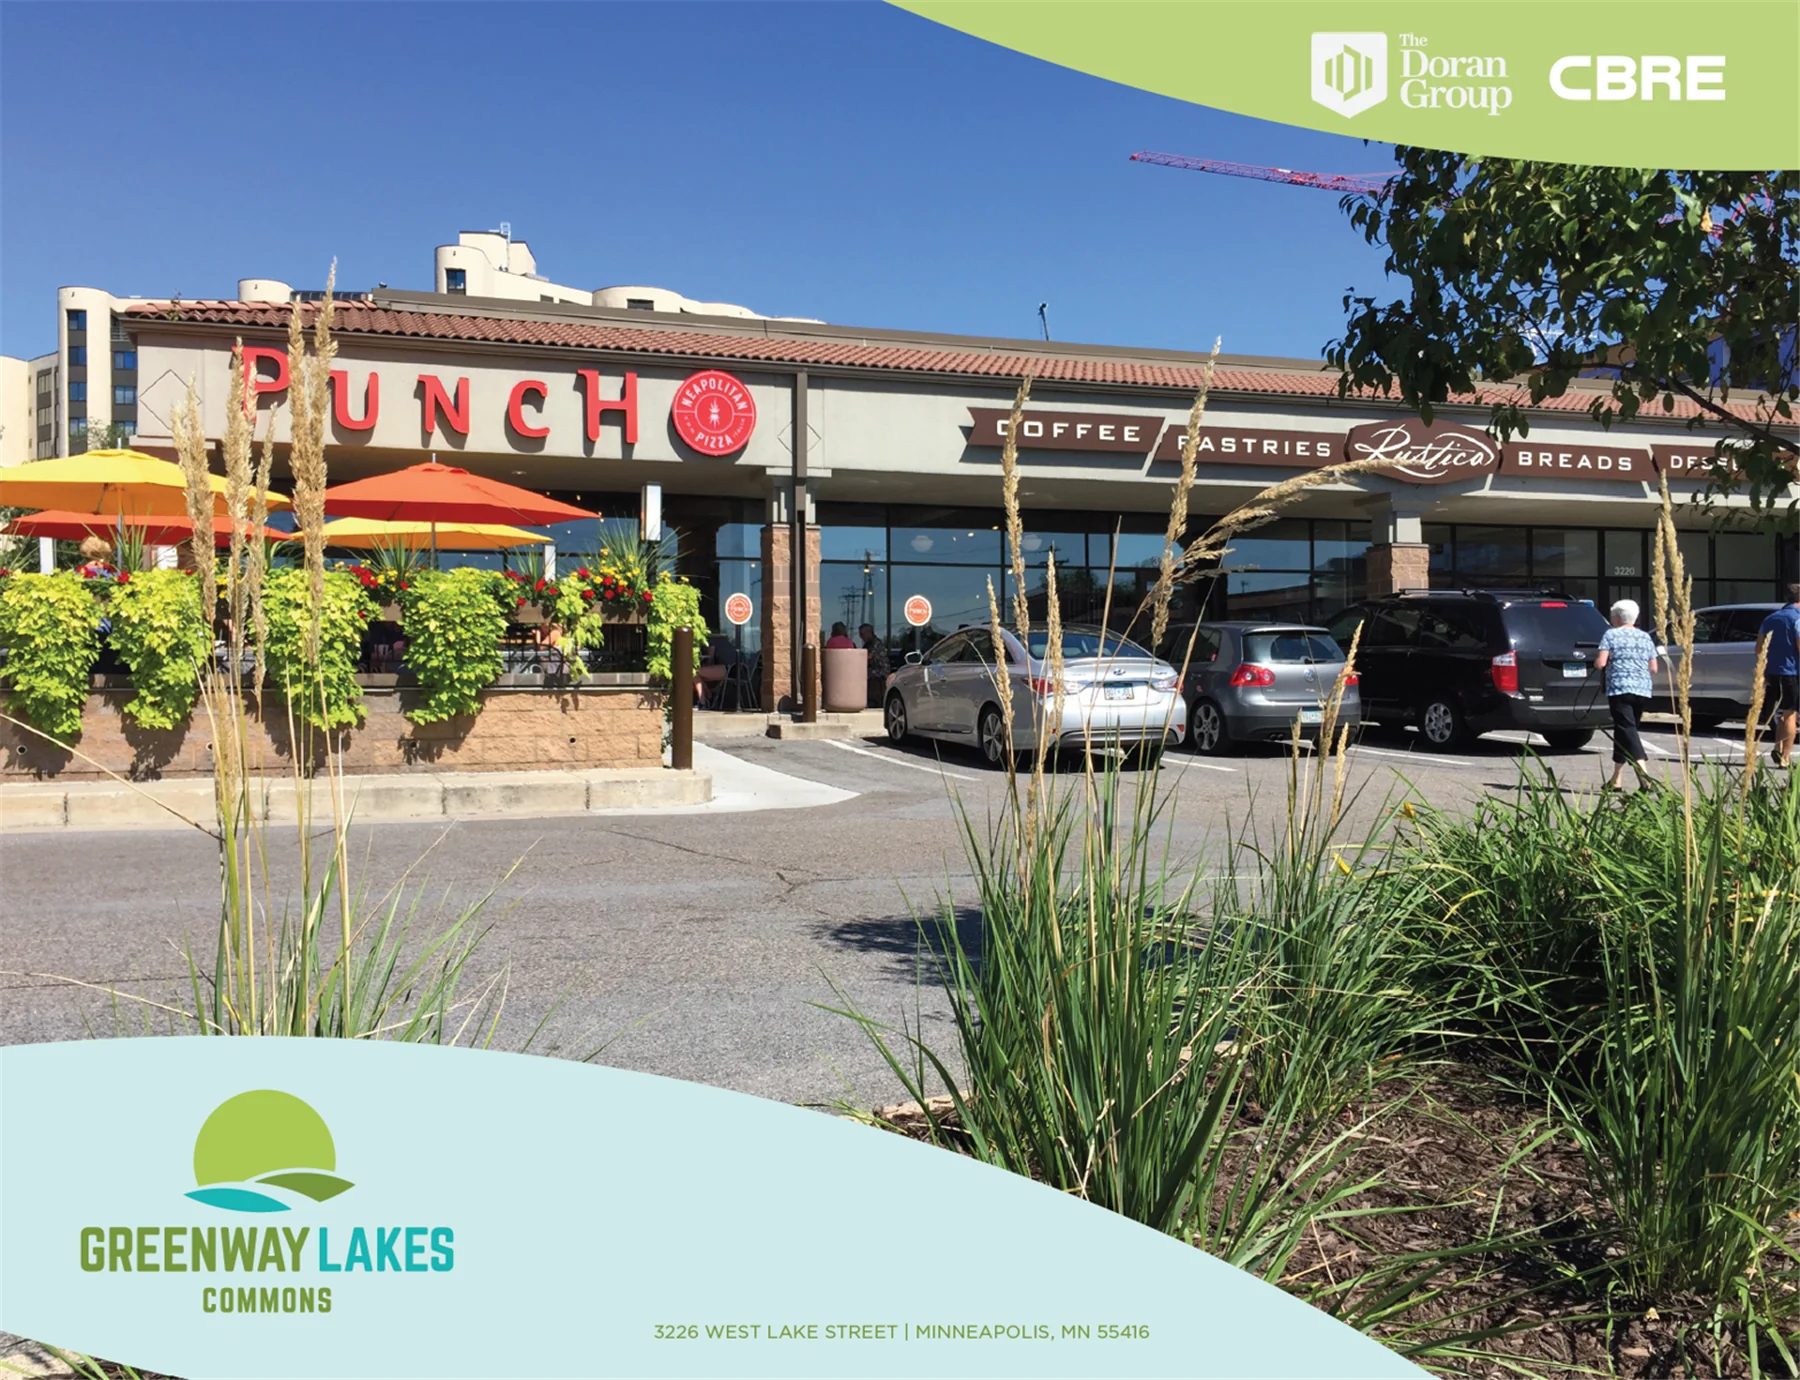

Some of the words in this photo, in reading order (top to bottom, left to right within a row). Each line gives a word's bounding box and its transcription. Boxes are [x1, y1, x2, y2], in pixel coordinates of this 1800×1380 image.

[231, 345, 638, 444] PUNCH
[681, 377, 748, 410] NEAPOLITAN
[694, 431, 734, 449] PIZZA
[996, 419, 1141, 443] COFFEE
[1177, 434, 1331, 459] PASTRIES
[1354, 423, 1495, 478] Rustica
[1518, 451, 1633, 472] BREADS
[1614, 565, 1635, 576] 3220
